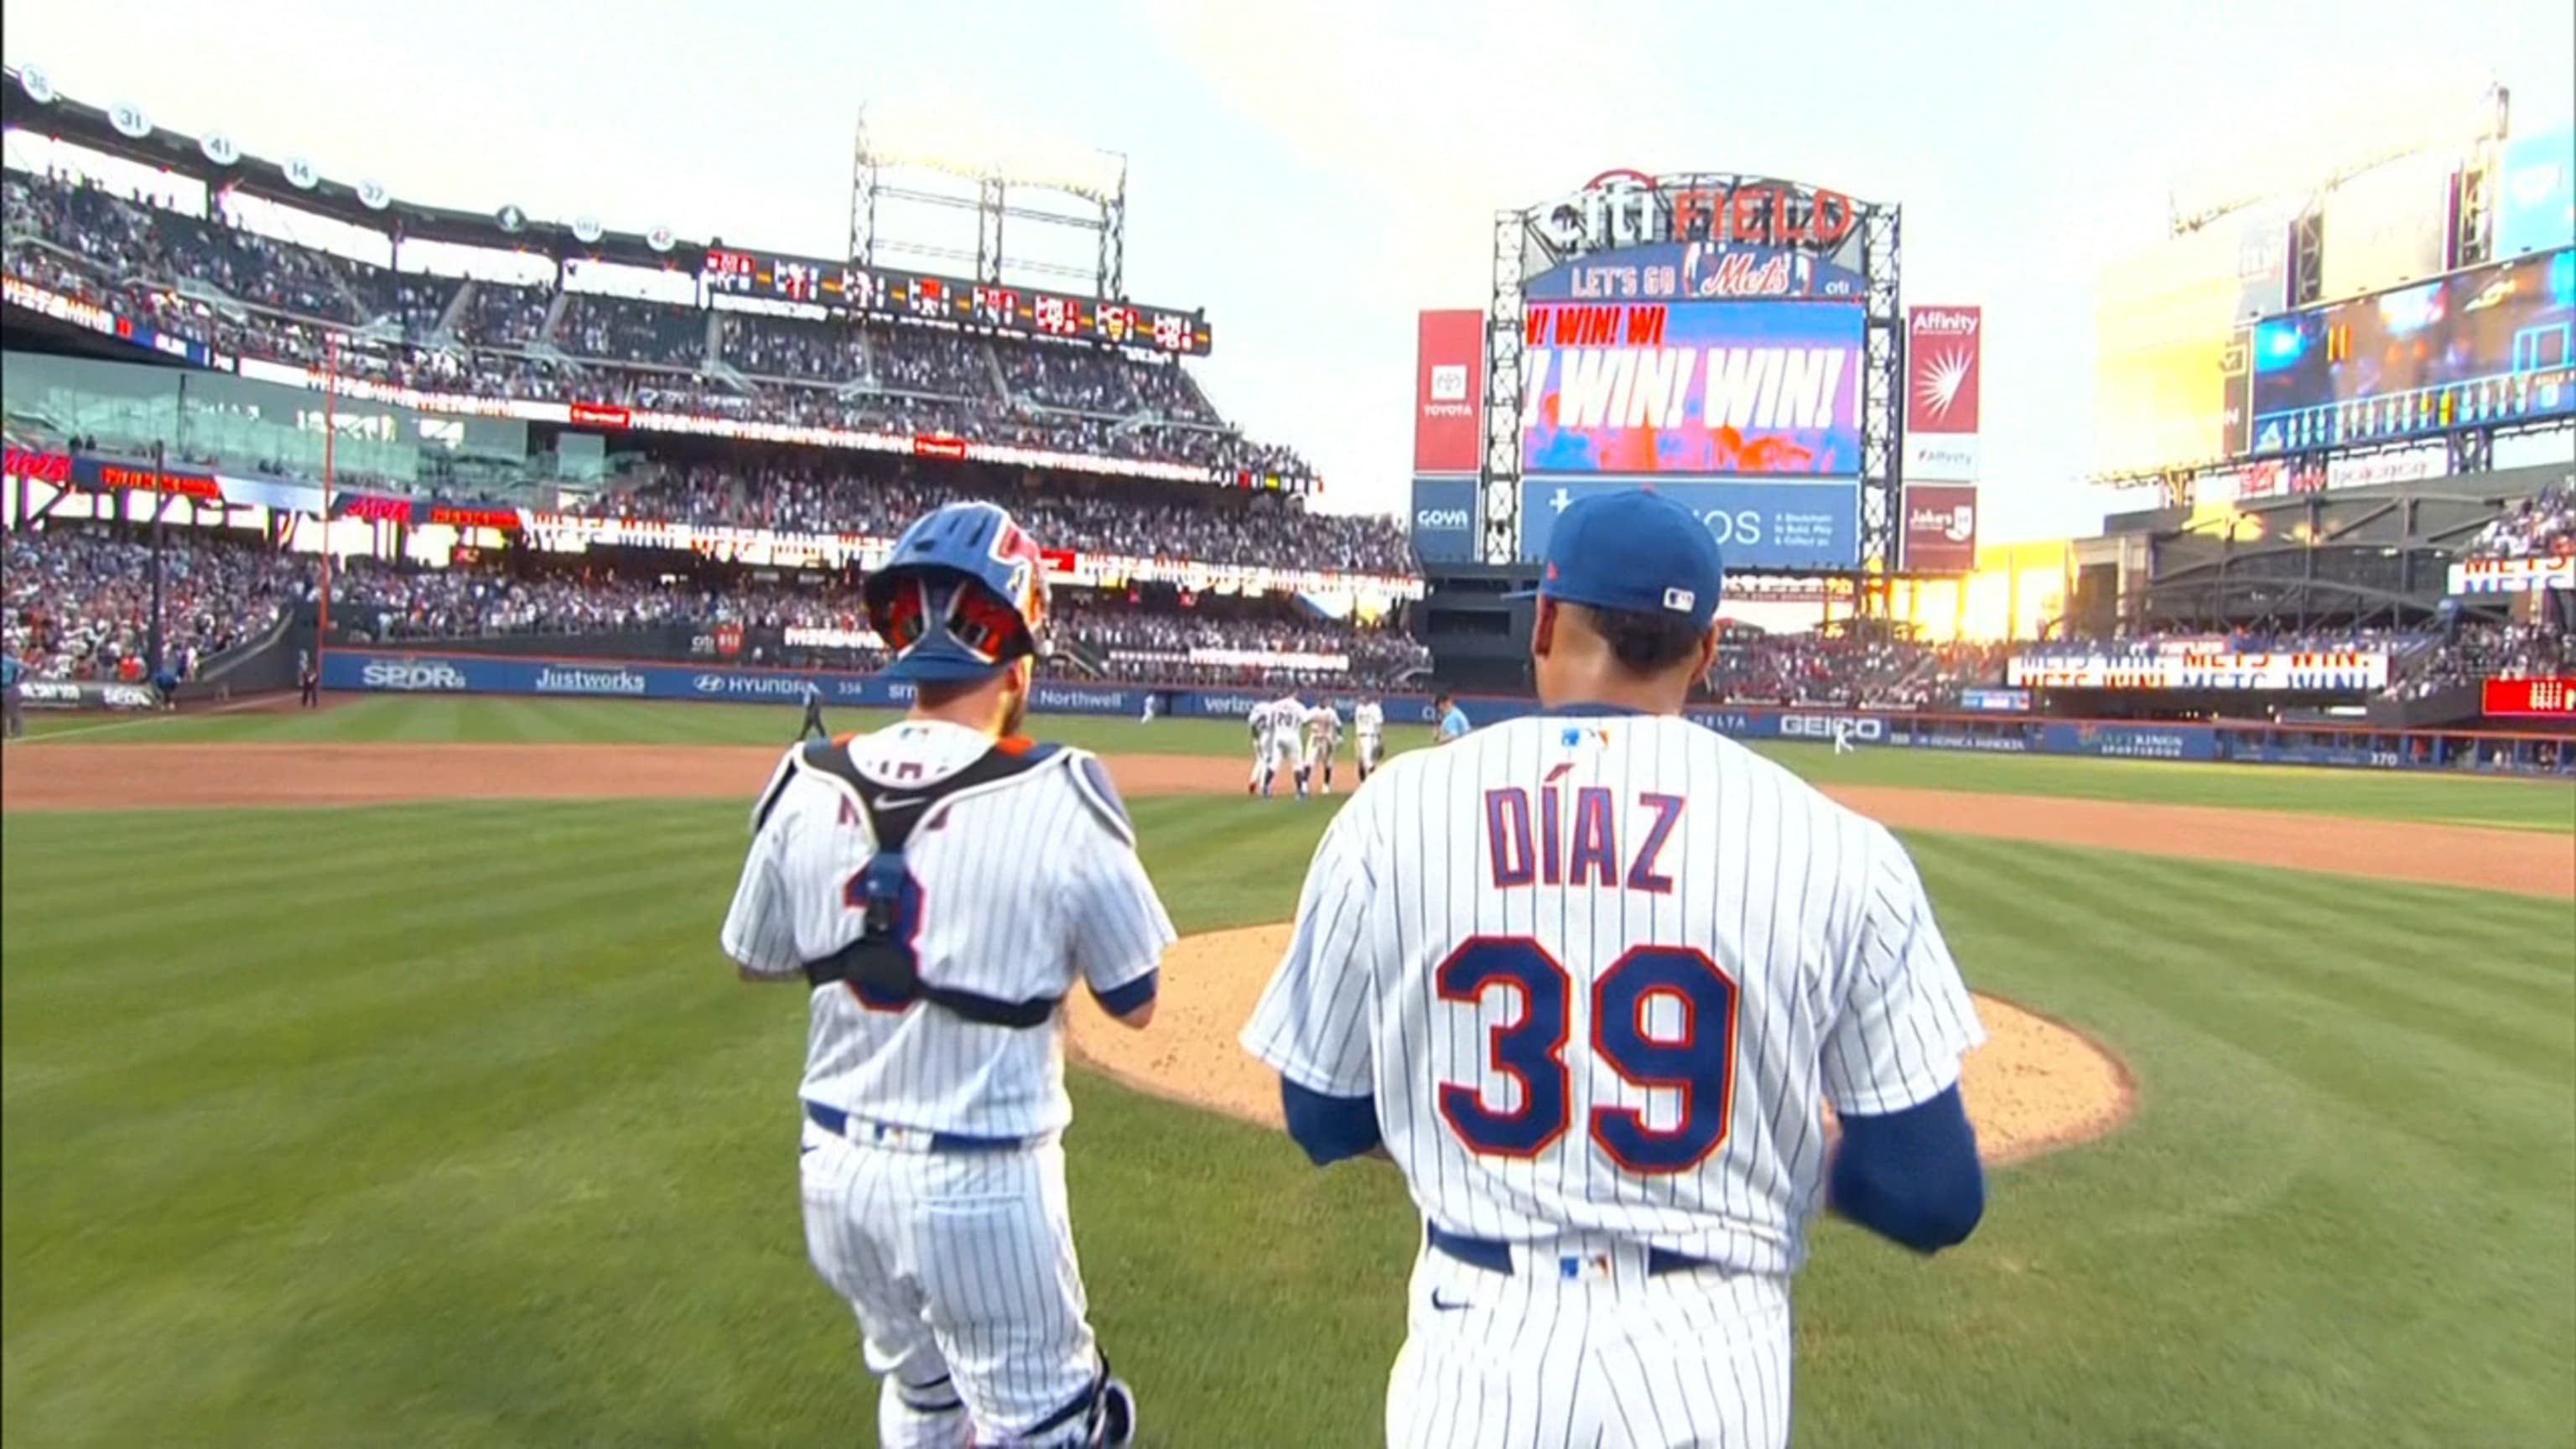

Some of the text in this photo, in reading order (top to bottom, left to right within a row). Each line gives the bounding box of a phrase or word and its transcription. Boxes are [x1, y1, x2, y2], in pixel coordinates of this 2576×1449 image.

[119, 108, 141, 130] 31
[210, 138, 231, 155] 41
[292, 163, 309, 179] 14
[1542, 184, 1852, 243] citi FIELD
[1571, 252, 1789, 298] LET'S GO Mets
[1555, 307, 1621, 345] WIN!
[1626, 306, 1666, 345] WI
[1913, 311, 1978, 334] Affinity
[1559, 348, 1698, 428] WIN!
[1704, 348, 1846, 428] WIN!
[1424, 404, 1472, 416] TOYOTA
[1417, 508, 1468, 527] GOYA
[535, 667, 645, 693] Justworks
[729, 678, 811, 695] HYUNDA
[1040, 689, 1124, 707] Northwell
[1205, 694, 1258, 712] verizo
[1780, 714, 1882, 739] GEICO
[1484, 762, 1687, 895] DÍAZ
[1435, 934, 1737, 1174] 39
